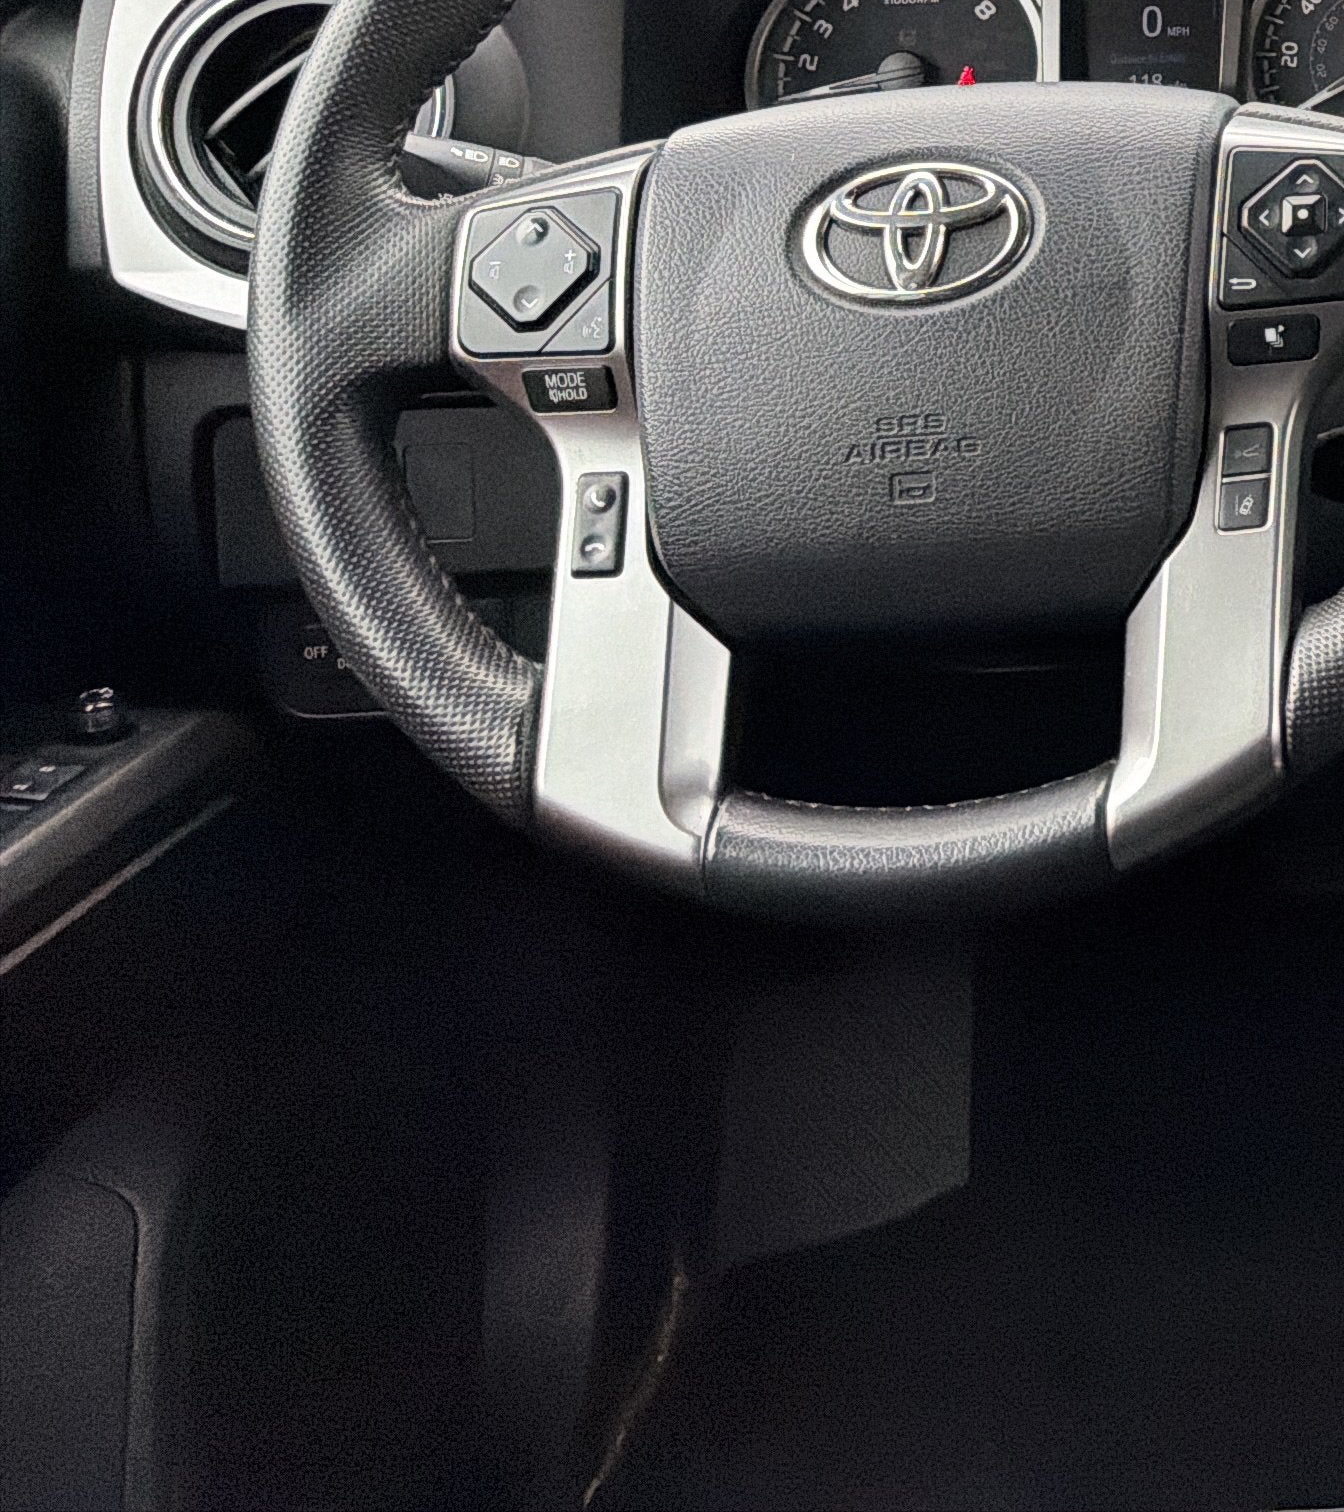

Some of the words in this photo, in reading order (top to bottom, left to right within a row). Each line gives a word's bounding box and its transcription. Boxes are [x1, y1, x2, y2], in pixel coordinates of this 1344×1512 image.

[974, 0, 997, 21] 8
[814, 19, 834, 39] 3
[1142, 5, 1164, 38] 0
[1167, 26, 1191, 38] MPH
[798, 52, 818, 72] 2
[1281, 40, 1299, 68] 20
[545, 371, 587, 388] MODE
[557, 387, 588, 401] HOLD
[876, 413, 950, 433] SRS
[844, 436, 982, 463] AIRBAG
[304, 646, 328, 660] OFF
